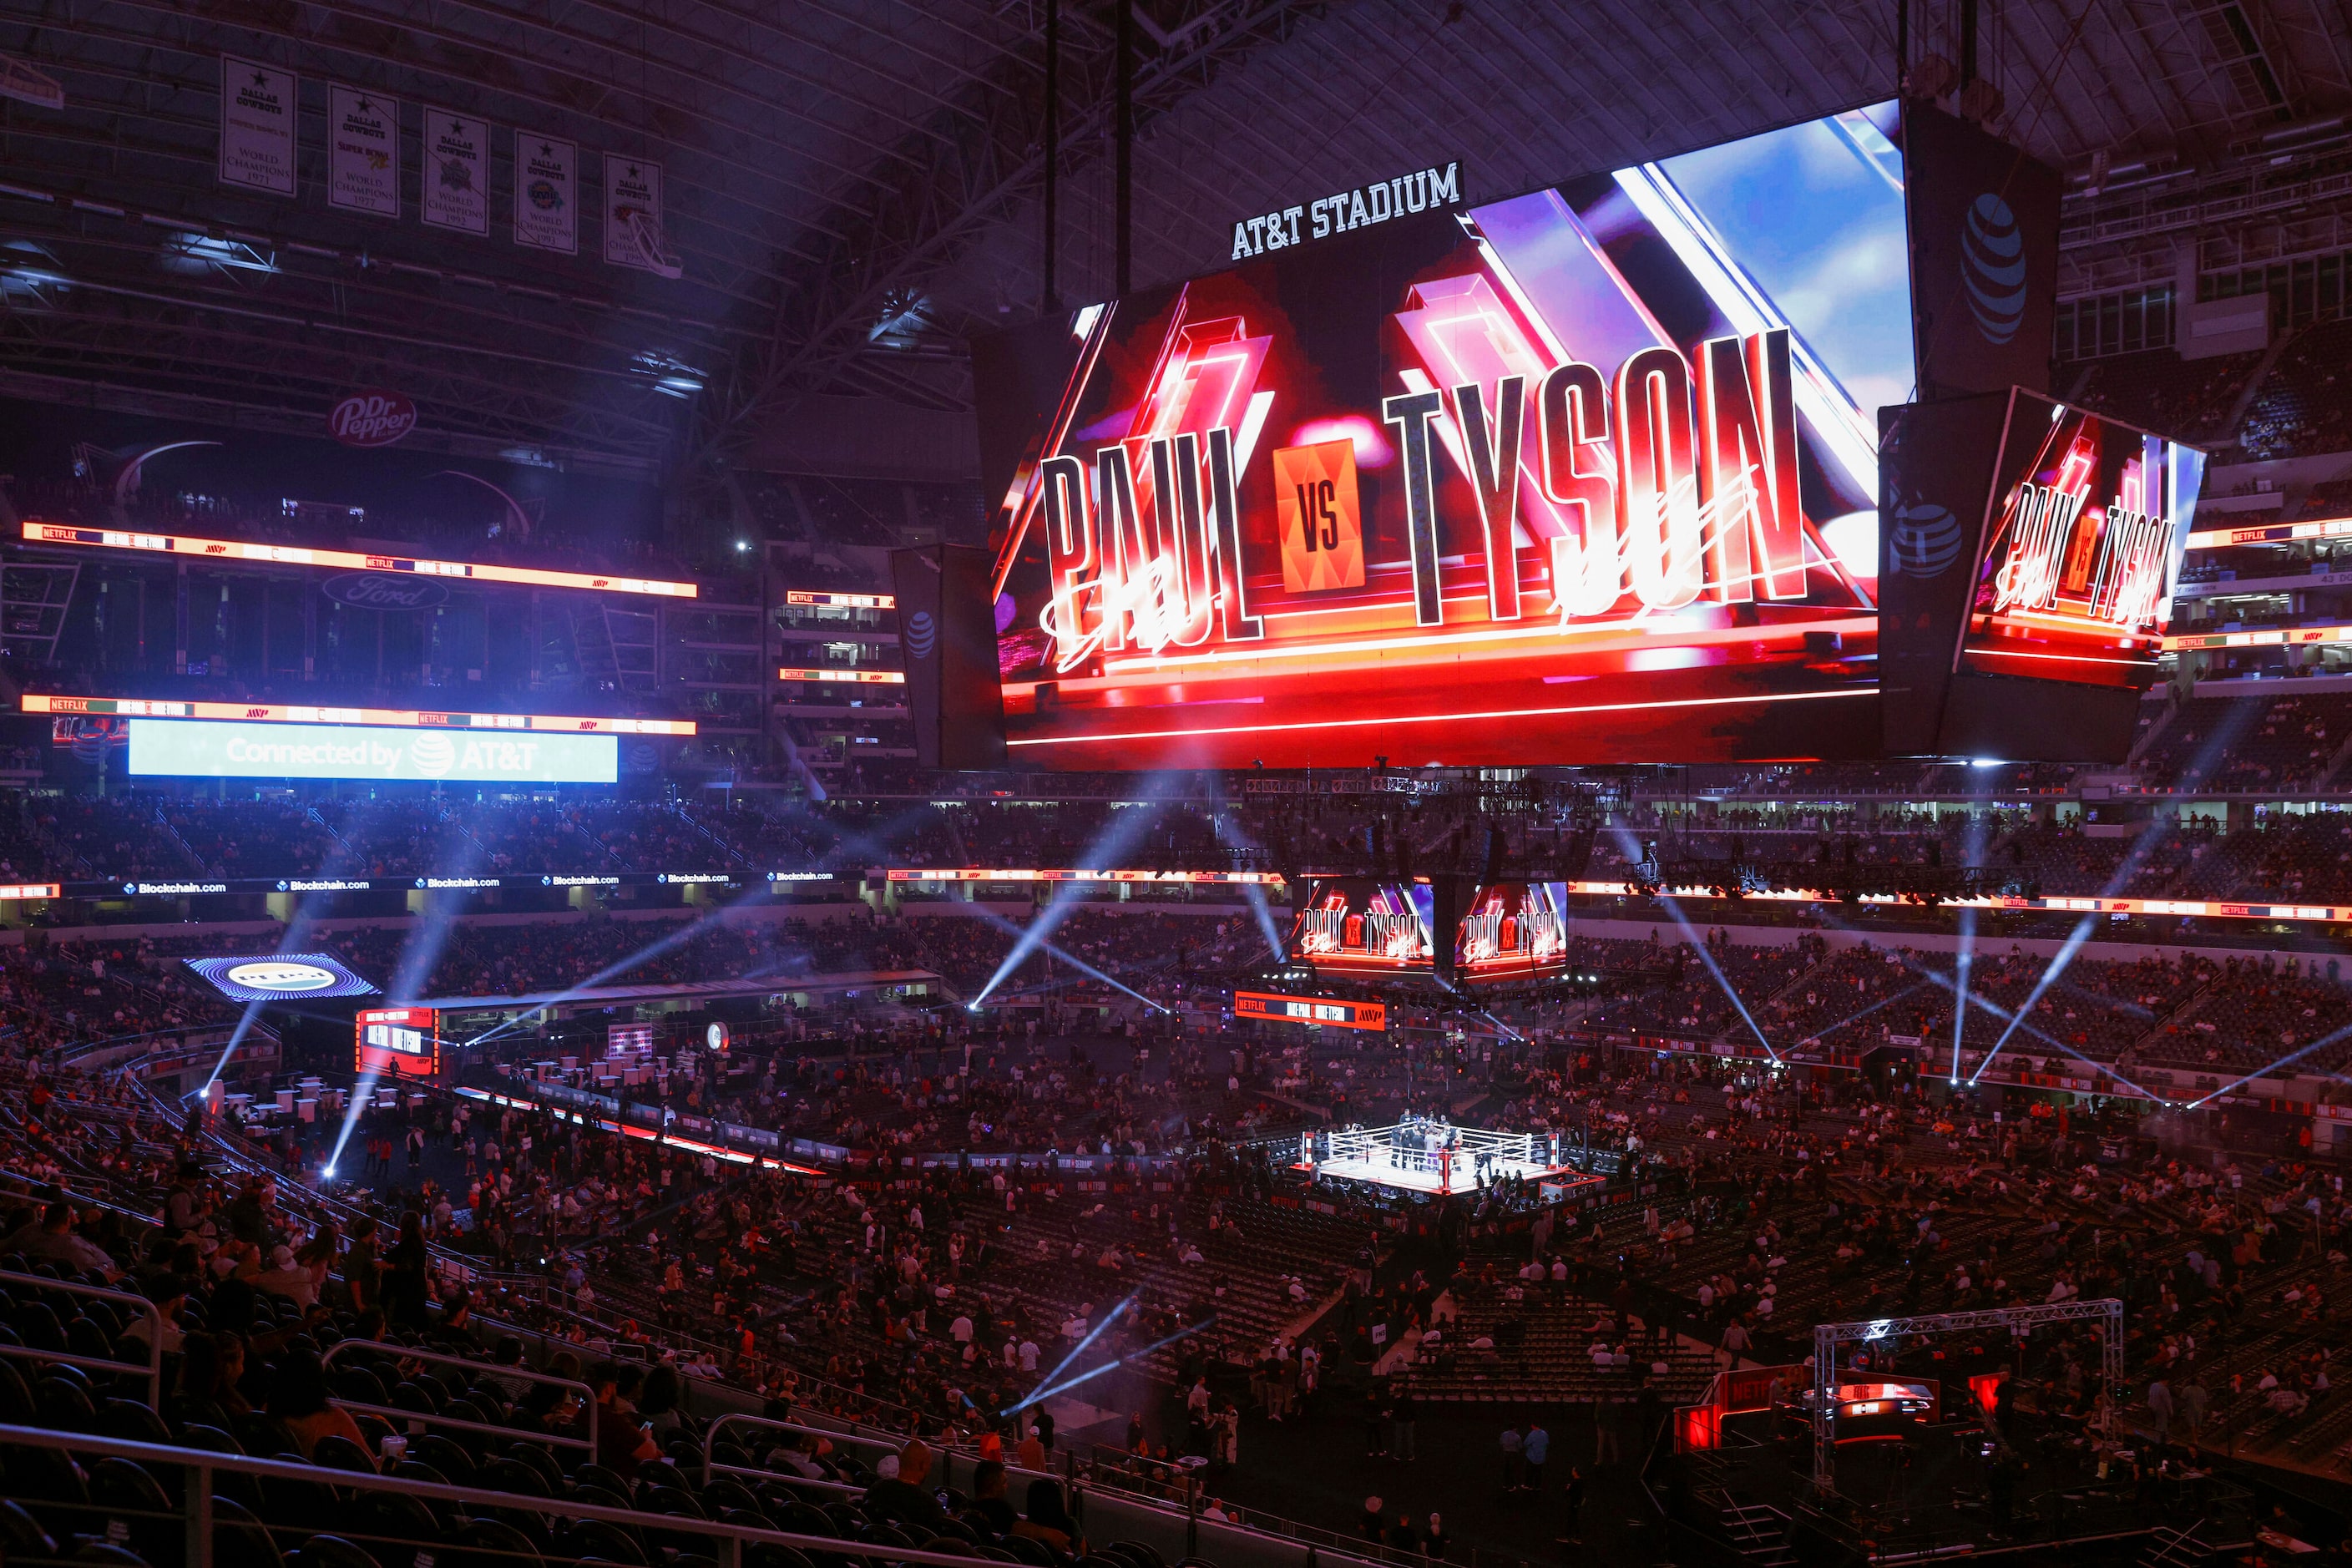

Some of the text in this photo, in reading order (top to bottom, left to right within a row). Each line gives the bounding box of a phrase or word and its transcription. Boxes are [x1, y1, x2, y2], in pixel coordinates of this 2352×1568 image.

[241, 87, 278, 104] DALLAS
[236, 96, 282, 114] COWBOYS
[346, 114, 382, 128] DALLAS
[342, 123, 385, 139] COWBOYS
[441, 136, 473, 150] DALLAS
[239, 147, 279, 164] WORLD
[437, 144, 477, 160] COWBOYS
[226, 156, 291, 179] CHAMPIONS
[531, 158, 562, 171] DALLAS
[247, 172, 270, 185] 1971
[346, 172, 382, 187] WORLD
[527, 166, 565, 181] COWBOYS
[335, 181, 394, 201] CHAMPIONS
[619, 180, 648, 192] DALLAS
[353, 195, 376, 208] 1977
[438, 191, 473, 206] WORLD
[615, 188, 651, 201] COWBOYS
[427, 200, 484, 220] CHAMPIONS
[1232, 162, 1460, 261] AT&T STADIUM
[529, 212, 562, 226] WORLD
[519, 220, 572, 238] CHAMPIONS
[365, 396, 397, 418] Dr
[331, 397, 412, 439] Pepper
[1040, 426, 1266, 656] PAUL
[1297, 479, 1338, 553] VS
[1383, 326, 1808, 628] TYSON
[43, 528, 77, 541] NETFLIX
[2233, 530, 2266, 543] NETFLIX
[1998, 482, 2077, 611] PAUL
[2087, 505, 2176, 626] TYSON
[366, 557, 394, 569] NETFLIX
[346, 575, 428, 605] Ford
[790, 594, 814, 603] NETFLIX
[2177, 638, 2206, 648] NETFLIX
[51, 699, 88, 711] NETFLIX
[419, 713, 448, 724] NETFLIX
[226, 736, 538, 773] Connected by AT&T
[427, 878, 500, 888] Blockchain.com
[553, 876, 620, 885] Blockchain.com
[668, 873, 729, 883] Blockchain.com
[776, 872, 833, 881] Blockchain.com
[139, 883, 226, 894] Blockchain.com
[290, 880, 370, 891] Blockchain.com
[2222, 906, 2249, 915] NETFLIX
[1302, 908, 1343, 953] PAUL
[1364, 912, 1421, 959] TYSON
[1466, 913, 1500, 959] PAUL
[1516, 911, 1558, 957] TYSON
[1238, 999, 1267, 1013] NETFLIX
[1732, 1379, 1771, 1403] NETF
